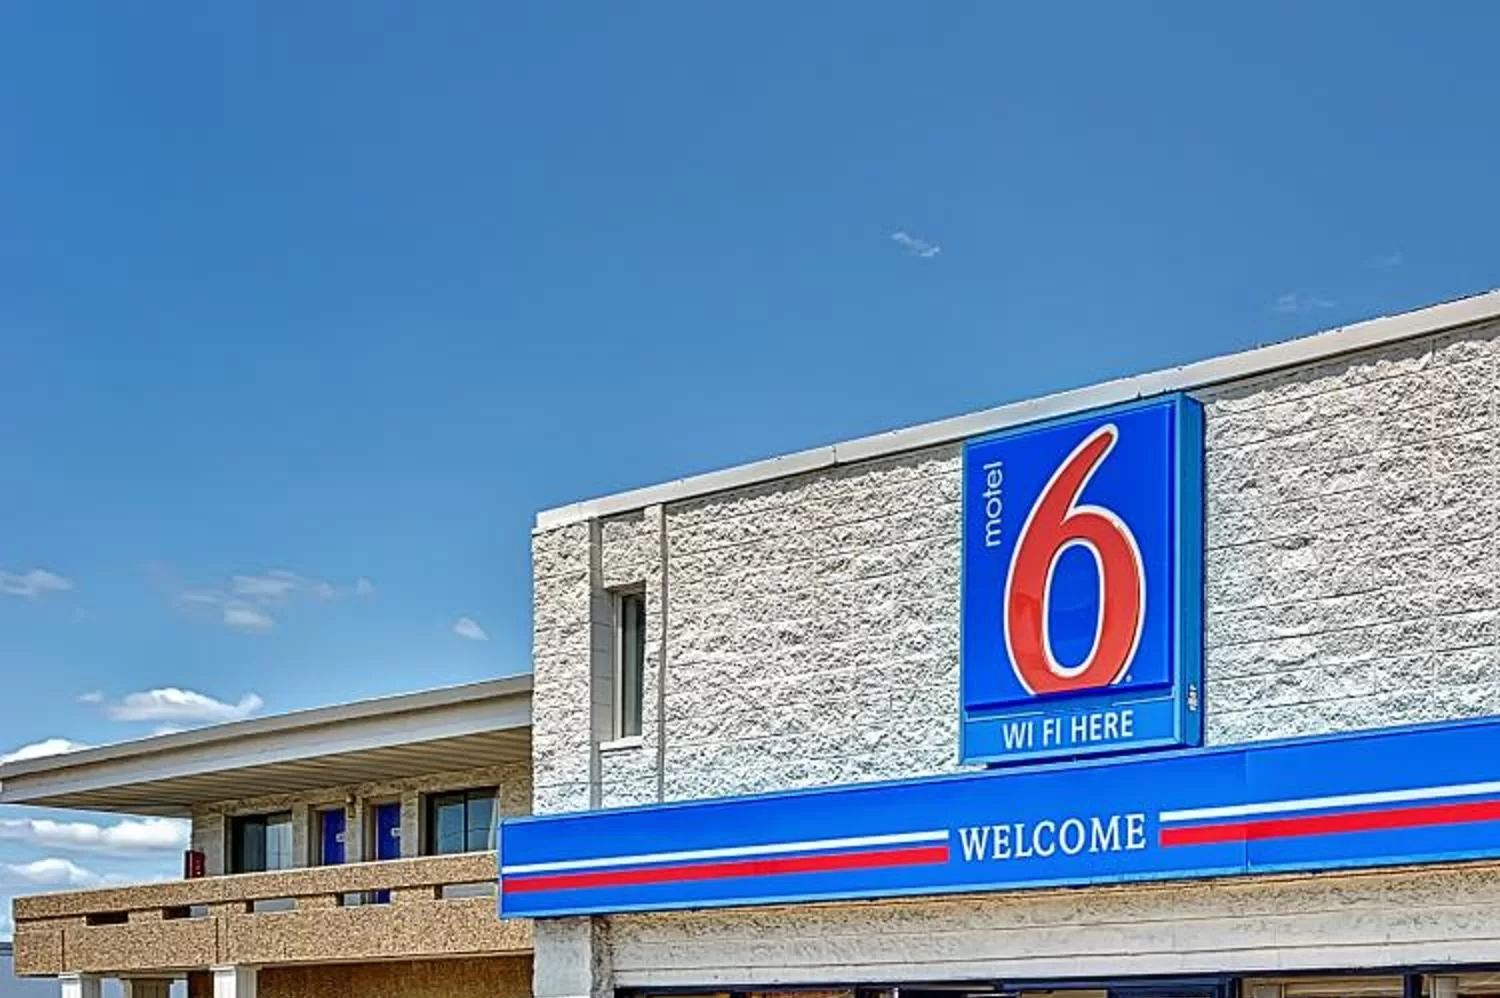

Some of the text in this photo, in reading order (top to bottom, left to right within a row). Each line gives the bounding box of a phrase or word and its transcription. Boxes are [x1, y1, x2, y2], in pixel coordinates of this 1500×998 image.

[982, 460, 1004, 548] motel
[1003, 422, 1147, 696] 6
[1002, 709, 1134, 750] WI FI HERE
[958, 812, 1147, 863] WELCOME
